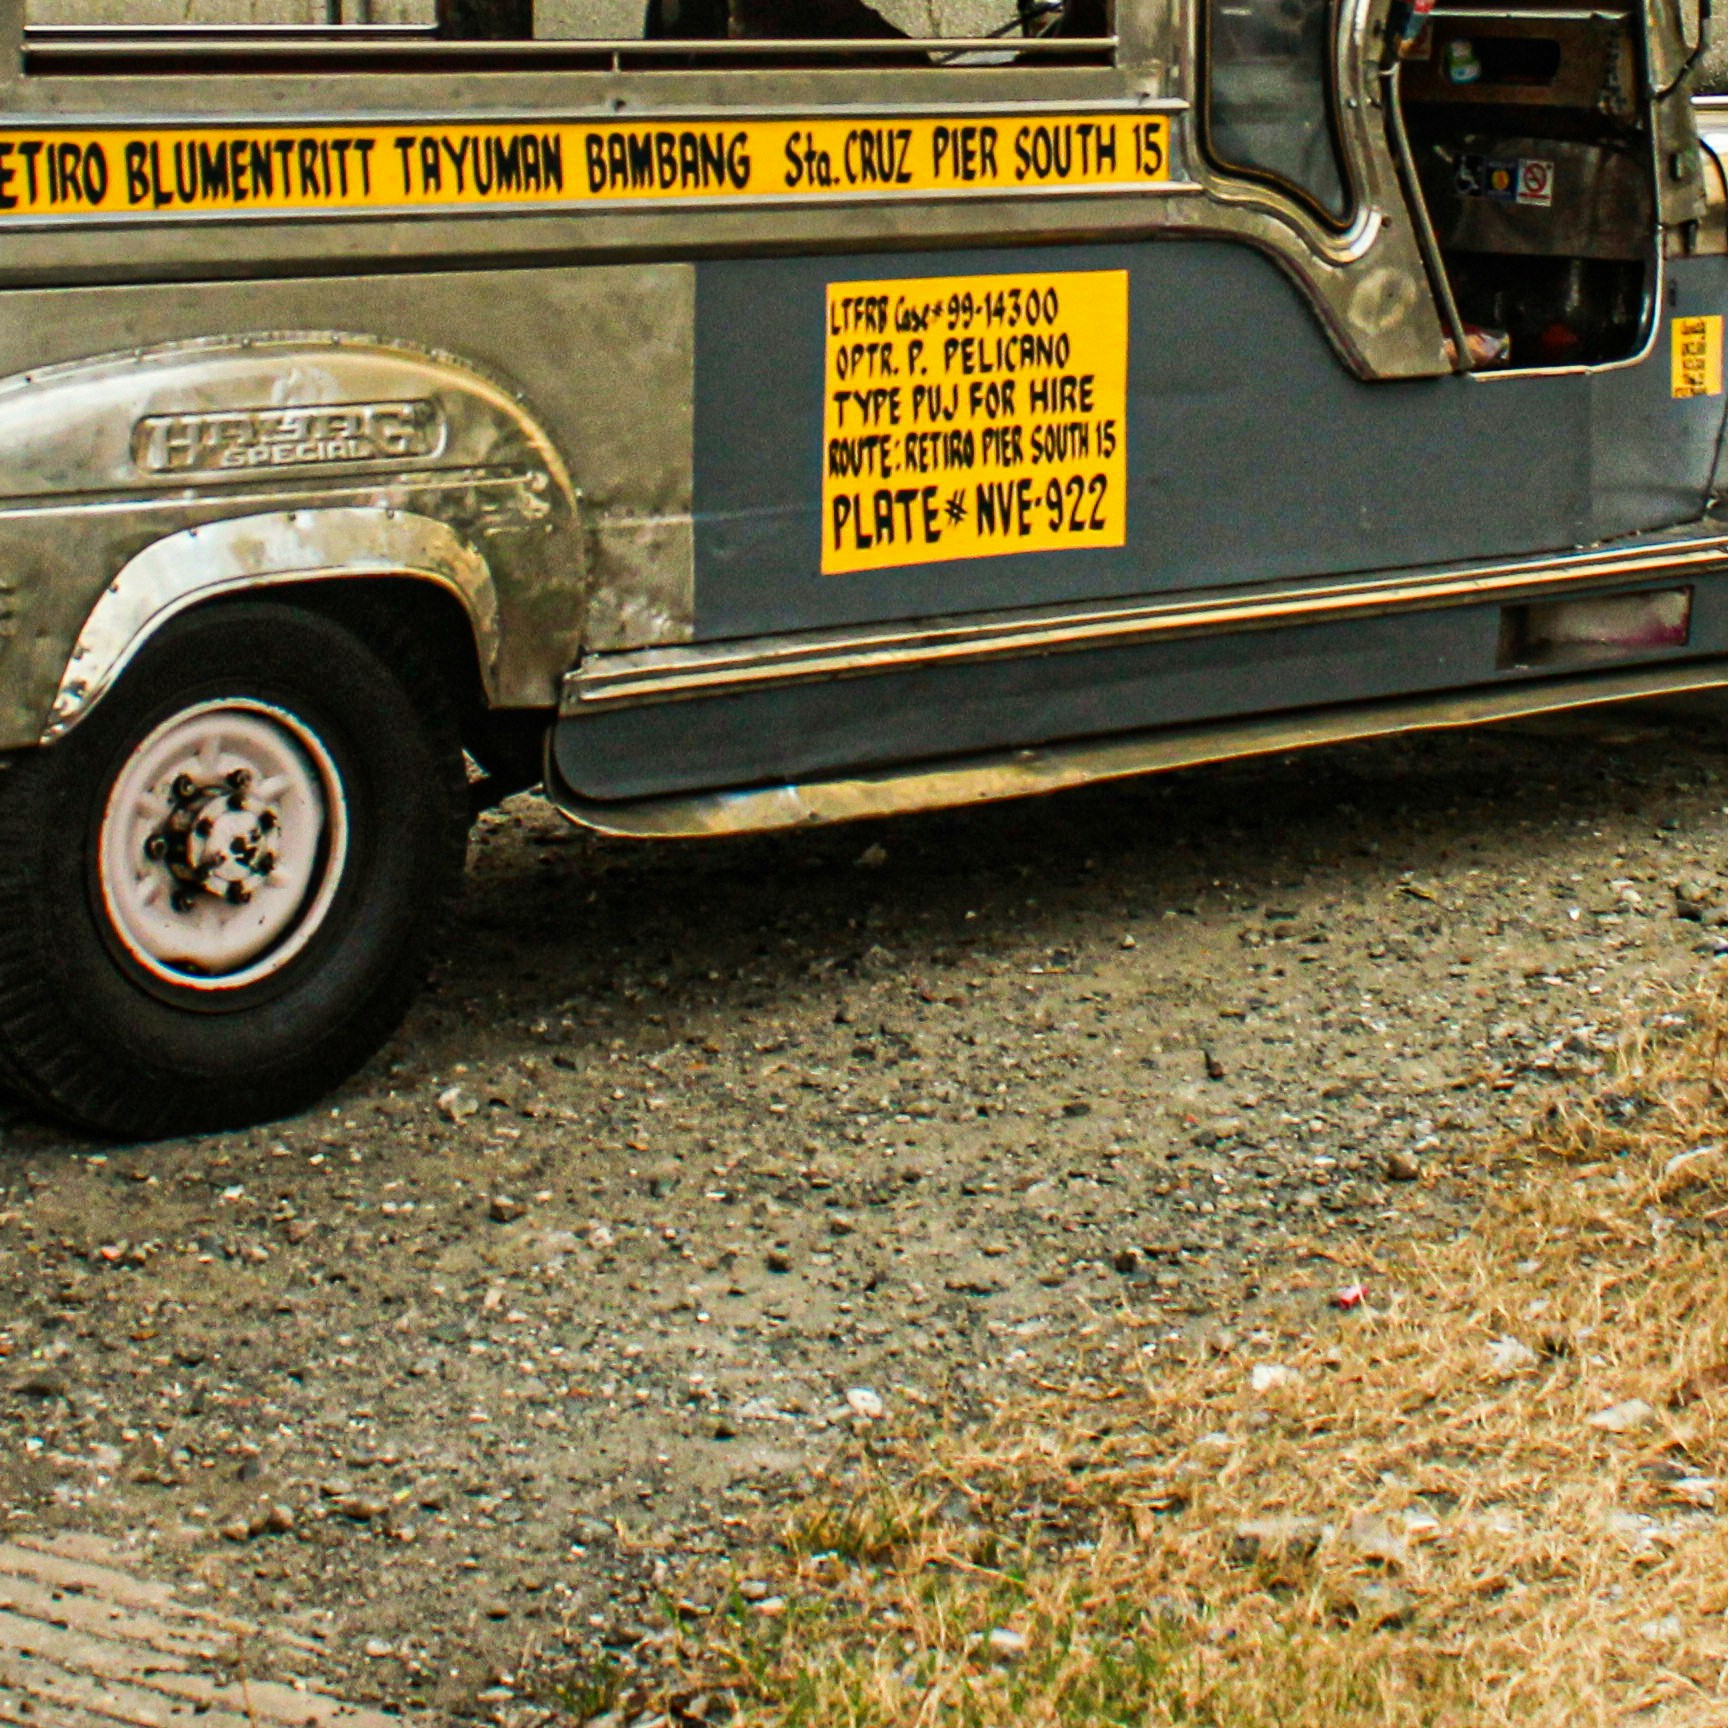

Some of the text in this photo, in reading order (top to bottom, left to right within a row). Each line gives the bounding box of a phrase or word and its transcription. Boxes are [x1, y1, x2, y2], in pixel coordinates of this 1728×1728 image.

[124, 138, 376, 209] BLUMENTRITT
[393, 134, 563, 196] TAYUMAN
[585, 131, 751, 194] BAMBANG
[932, 125, 998, 181] PIER
[1014, 123, 1117, 181] SOUTH
[1133, 122, 1162, 176] 15
[831, 295, 889, 336] LTFRB
[836, 332, 1070, 380] OPTR. P. PELICANO
[833, 374, 1095, 427] TYPE PUJ FOR HIRE
[221, 438, 371, 468] SPECIAL
[905, 429, 975, 473] RETIRO
[981, 425, 1024, 468] PIER
[1030, 422, 1089, 465] SOUTH
[1096, 419, 1116, 459] 15
[976, 473, 1107, 536] NVE-922
